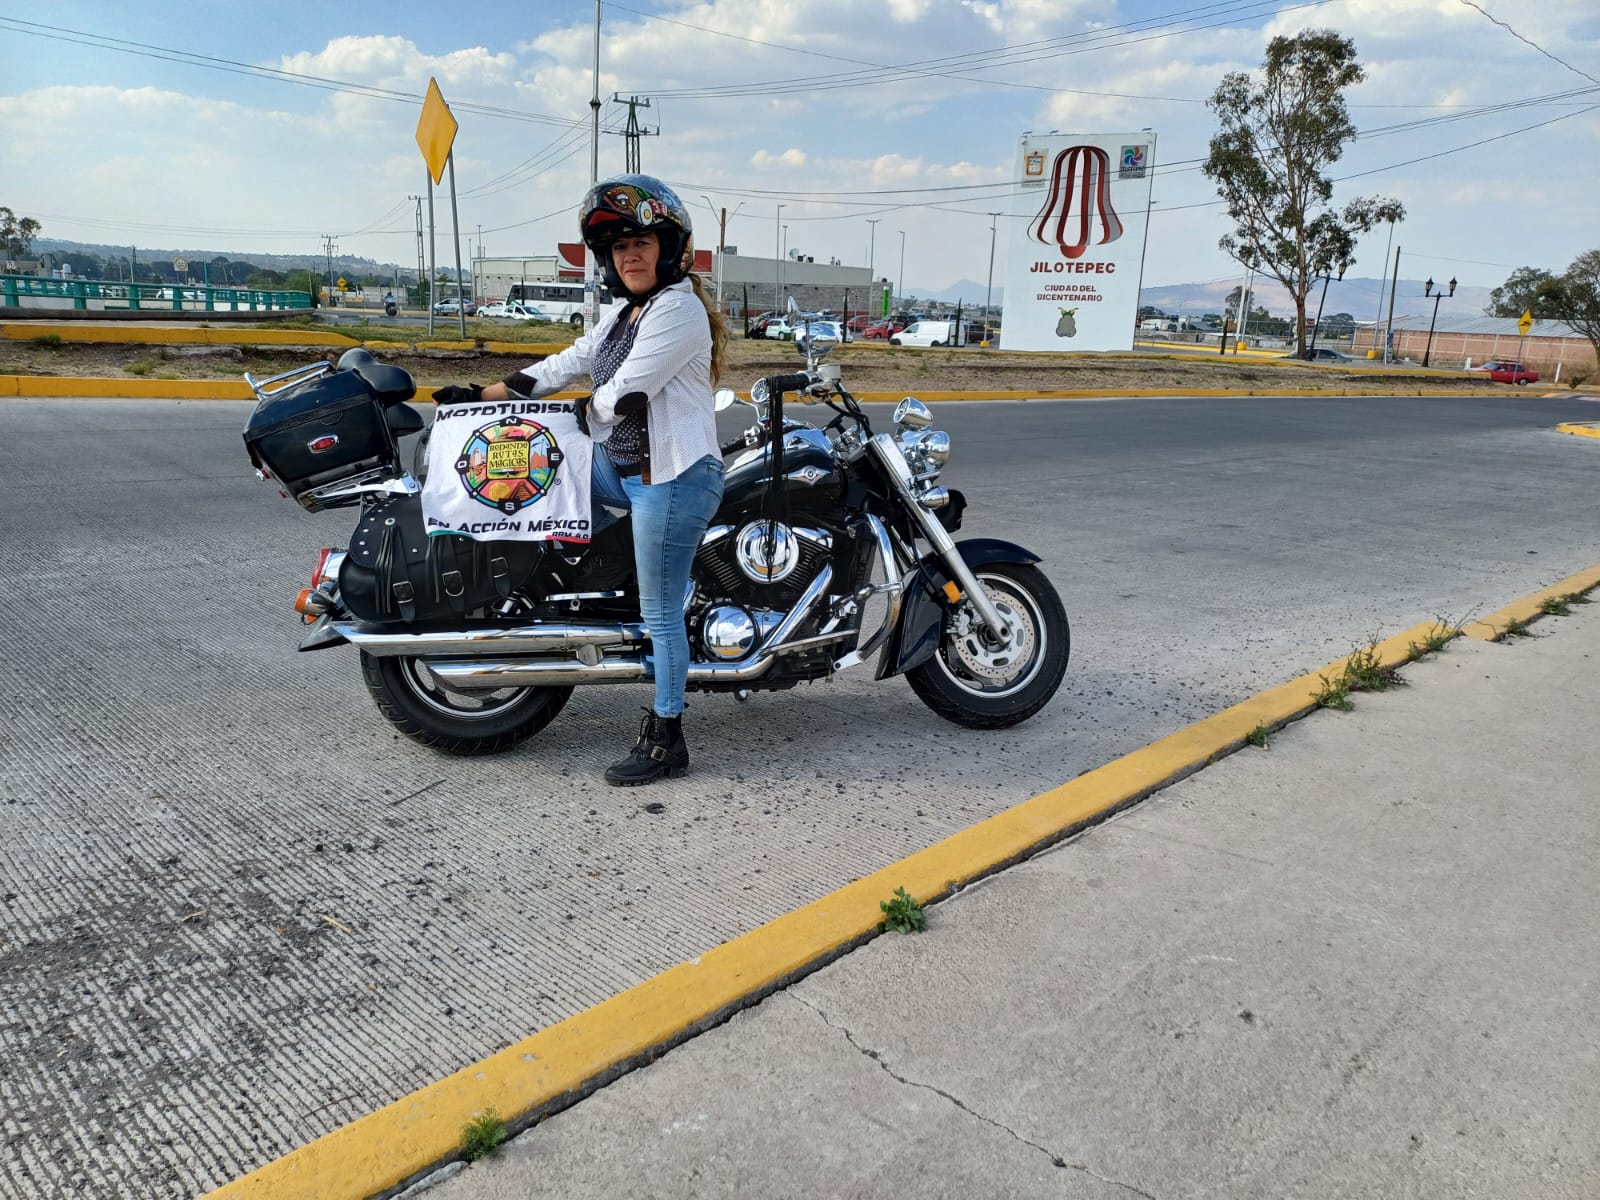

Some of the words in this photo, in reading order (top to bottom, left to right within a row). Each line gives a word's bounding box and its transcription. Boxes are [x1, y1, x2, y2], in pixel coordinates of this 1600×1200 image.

[1030, 262, 1115, 273] JILOTEPEC
[1037, 293, 1102, 302] BICENTENARIO
[505, 502, 515, 510] S
[428, 517, 450, 528] EN
[457, 518, 522, 533] ACCIÓN
[528, 516, 590, 531] MÉXICO
